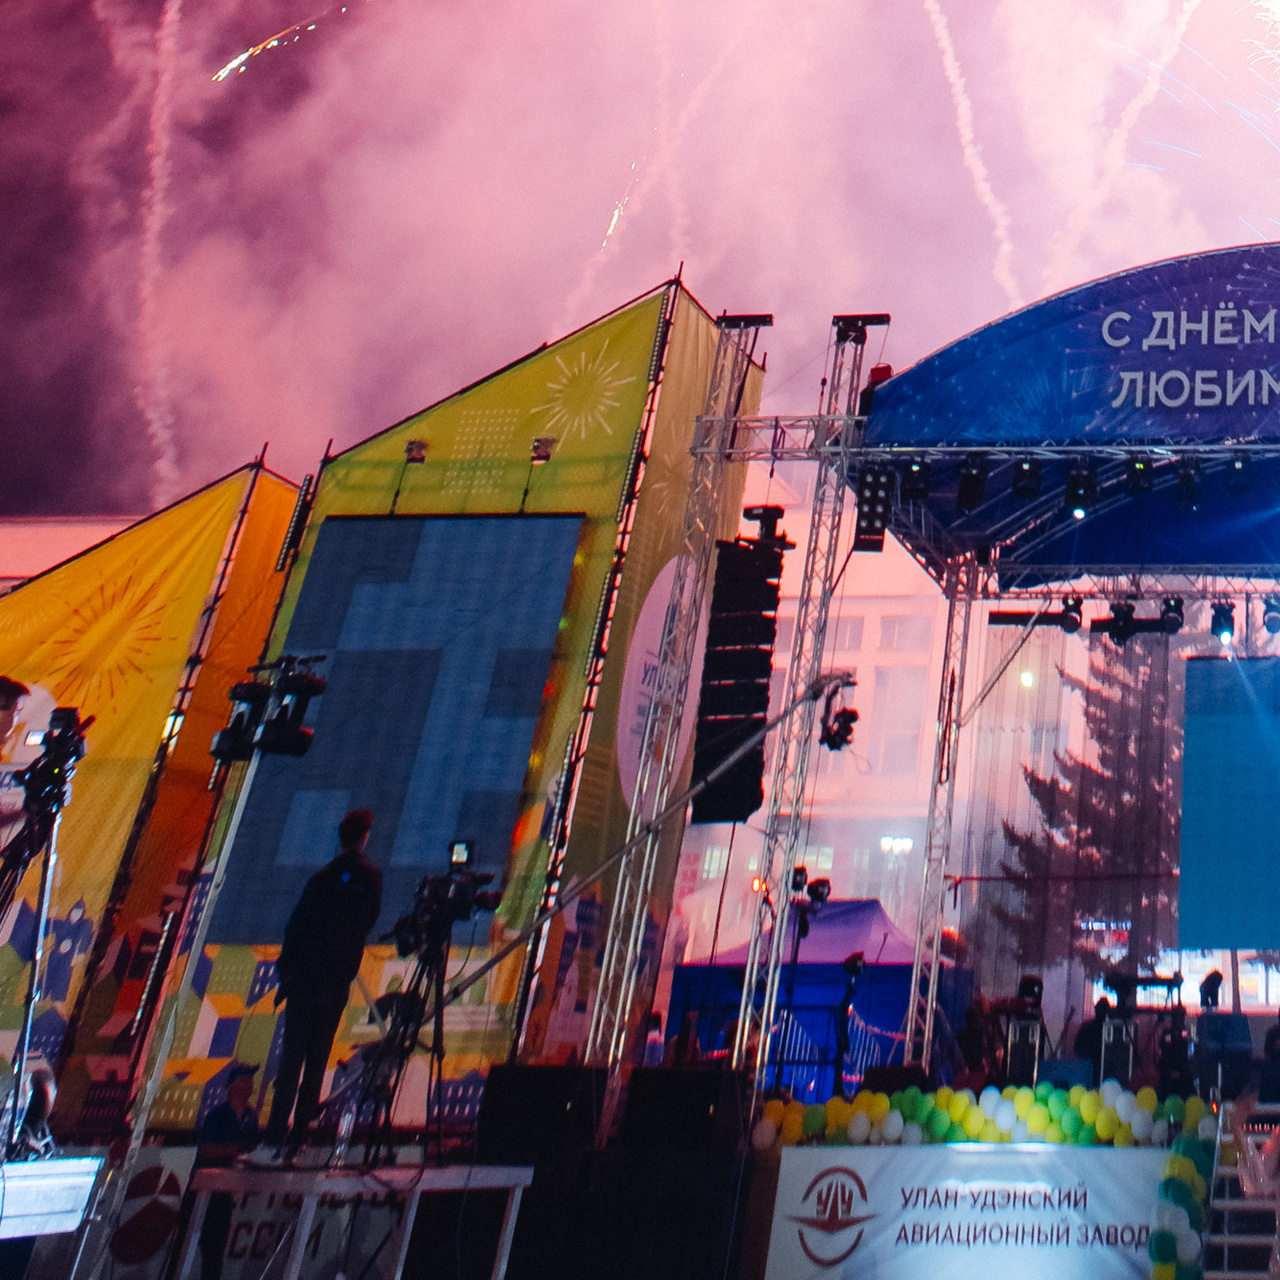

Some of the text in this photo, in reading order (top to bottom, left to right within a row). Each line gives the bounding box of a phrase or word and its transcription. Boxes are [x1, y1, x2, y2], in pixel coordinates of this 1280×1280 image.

[1101, 311, 1132, 348] С
[1142, 301, 1277, 352] ДНЁМ
[900, 1180, 1089, 1213] УЛАН-УДЭНСКИЙ
[895, 1217, 1150, 1252] АВИАЦИОННЫЙ ЗАВОД
